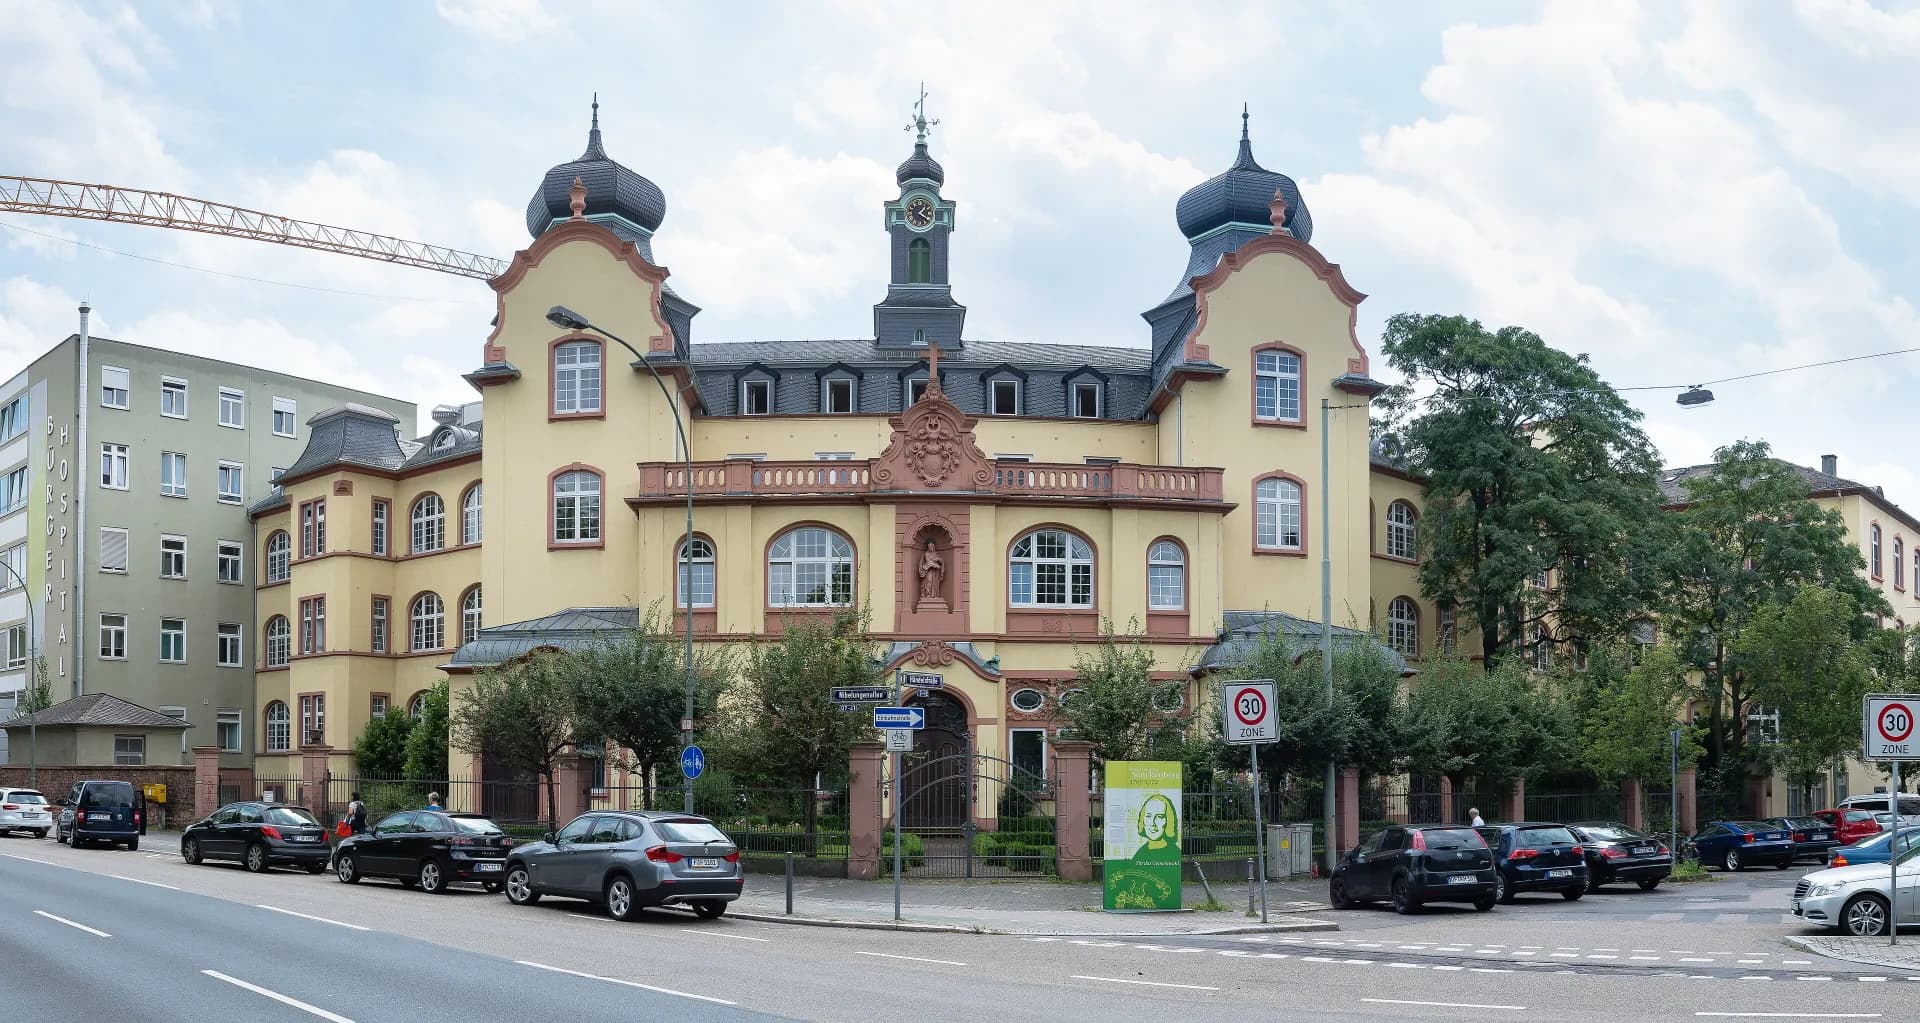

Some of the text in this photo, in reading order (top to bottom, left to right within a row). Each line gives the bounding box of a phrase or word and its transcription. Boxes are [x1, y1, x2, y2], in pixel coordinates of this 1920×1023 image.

[45, 415, 54, 603] BÜRGER
[58, 423, 69, 676] HOSPITAL
[1241, 698, 1260, 715] 30
[1885, 713, 1906, 731] 30
[1240, 727, 1265, 737] ZONE
[1881, 744, 1910, 754] ZONE
